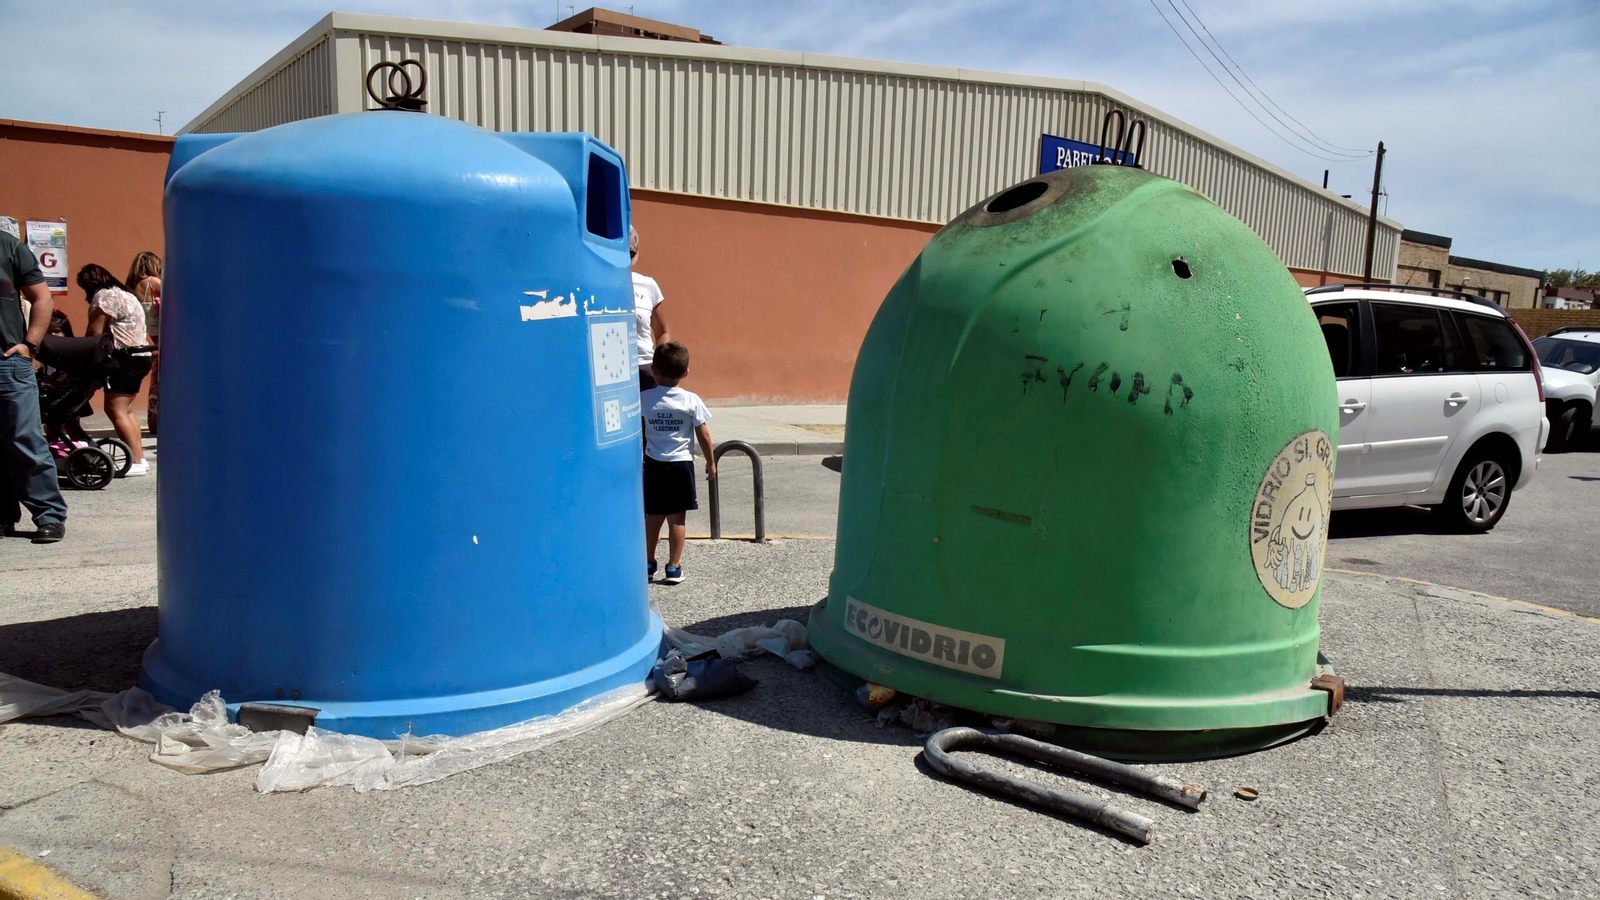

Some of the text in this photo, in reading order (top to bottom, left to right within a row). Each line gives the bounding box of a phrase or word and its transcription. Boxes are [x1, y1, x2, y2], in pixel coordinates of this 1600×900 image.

[40, 252, 57, 268] G
[1254, 457, 1291, 544] VIDRIO
[847, 603, 996, 670] ECOVIDRIO
